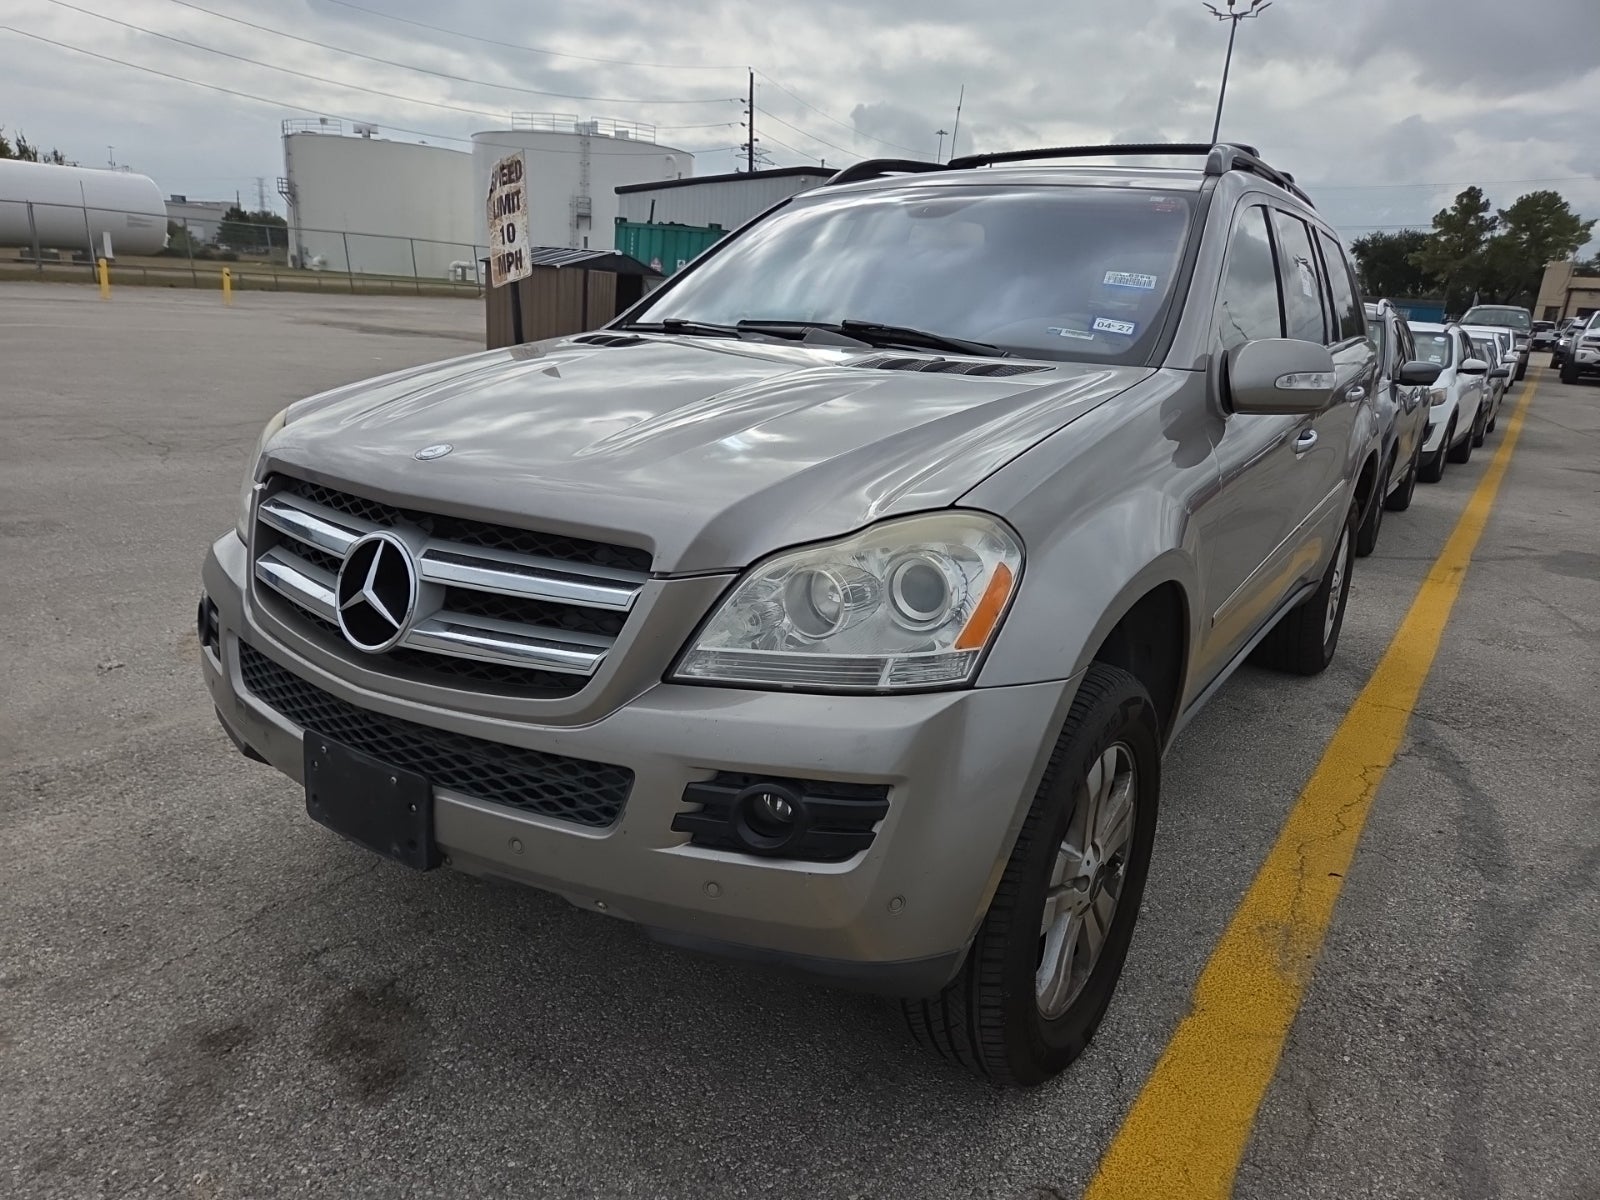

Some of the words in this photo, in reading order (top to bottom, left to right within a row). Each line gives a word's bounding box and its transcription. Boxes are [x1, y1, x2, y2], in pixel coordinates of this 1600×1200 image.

[493, 190, 521, 220] LIMIT
[500, 222, 516, 245] 10
[498, 248, 523, 277] MPH
